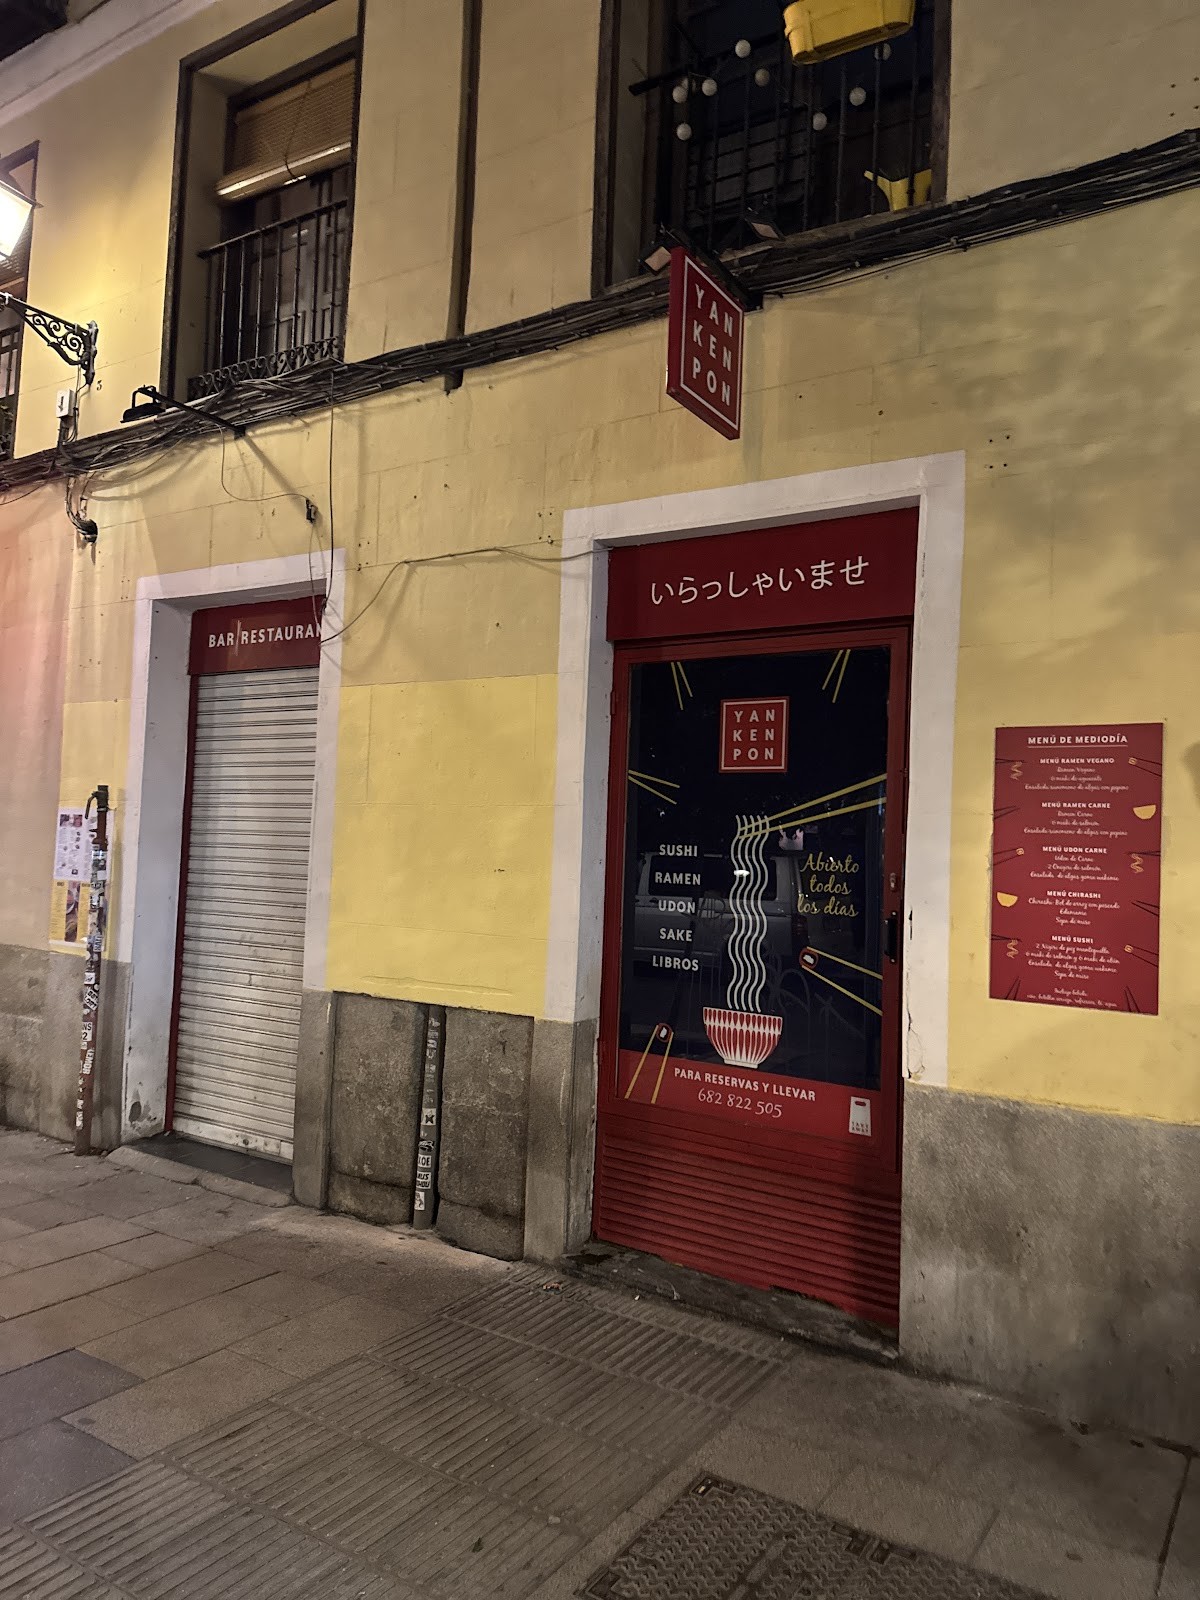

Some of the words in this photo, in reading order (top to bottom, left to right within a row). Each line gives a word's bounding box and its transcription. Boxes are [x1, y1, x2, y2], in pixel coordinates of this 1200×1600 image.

[695, 284, 733, 338] YAN
[692, 320, 732, 372] KEN
[692, 356, 730, 406] PON
[651, 555, 870, 604] いらっしゃいませ
[208, 632, 234, 648] BAR
[734, 710, 775, 722] YAN
[733, 728, 774, 742] KEN
[1028, 735, 1056, 744] MENÚ
[1076, 733, 1128, 743] MEDIODÍA
[733, 748, 774, 760] PON
[660, 844, 698, 857] SUSHI
[800, 851, 859, 873] Abierto
[655, 872, 701, 885] RAMEN
[810, 874, 852, 894] todos
[658, 900, 695, 913] UDON
[797, 894, 820, 914] los
[824, 896, 859, 917] días
[660, 928, 692, 941] SAKE
[653, 955, 699, 971] LIBROS
[674, 1067, 701, 1081] PARA
[705, 1073, 759, 1091] RESERVAS
[762, 1082, 769, 1092] Y
[773, 1084, 816, 1101] LLEVAR
[698, 1088, 722, 1104] 682
[727, 1094, 752, 1110] 822
[755, 1101, 782, 1118] 505
